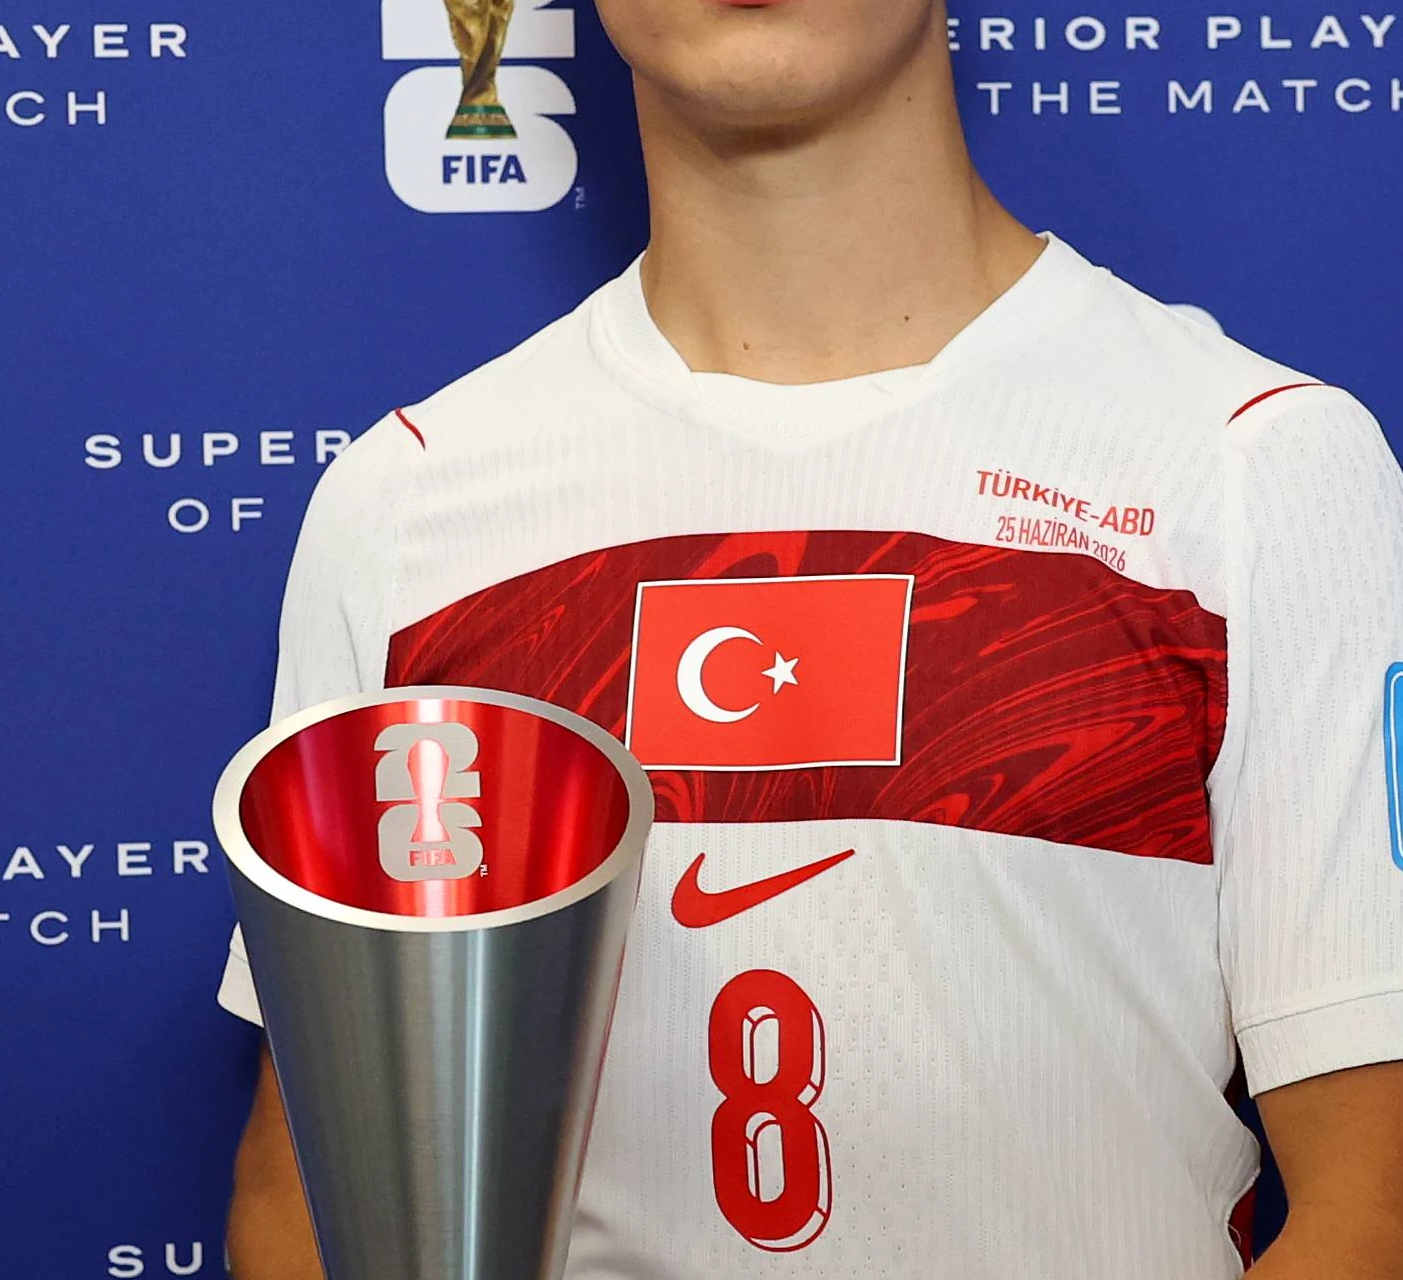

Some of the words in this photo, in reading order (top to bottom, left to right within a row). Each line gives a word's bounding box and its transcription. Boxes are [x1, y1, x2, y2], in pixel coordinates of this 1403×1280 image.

[976, 80, 1122, 116] THE
[441, 153, 528, 185] FIFA
[84, 429, 353, 470] SUPER
[167, 497, 265, 534] OF
[976, 469, 1155, 537] TÜRKİYE-ABD
[995, 516, 1017, 543] 25
[1018, 517, 1090, 551] HAZİRAN
[1092, 540, 1127, 572] 2026
[409, 849, 457, 867] FIFA
[708, 969, 833, 1253] 8
